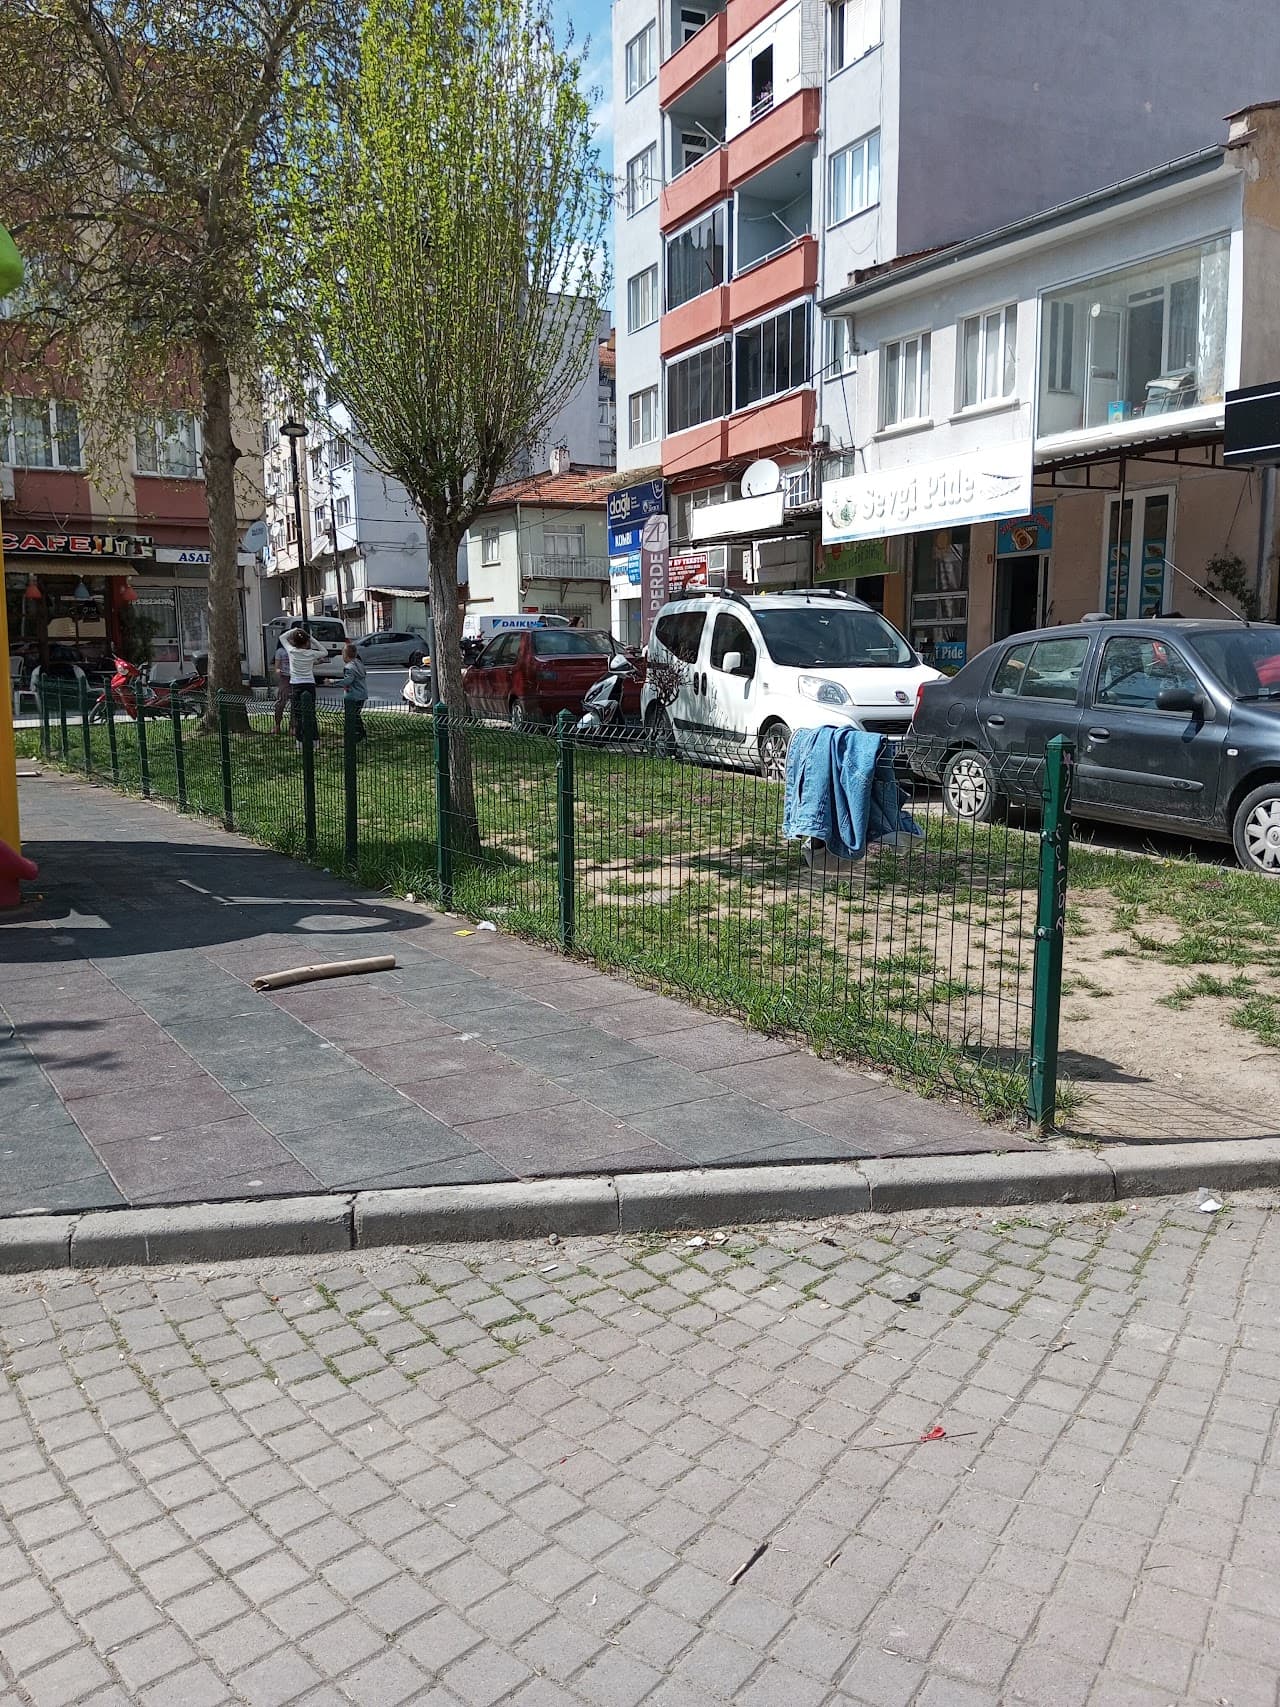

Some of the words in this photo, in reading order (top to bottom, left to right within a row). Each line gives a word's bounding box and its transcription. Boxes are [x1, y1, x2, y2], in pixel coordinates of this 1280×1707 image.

[863, 478, 917, 521] Sevgi
[924, 469, 975, 510] Pide
[2, 533, 91, 552] CAFE
[650, 553, 665, 611] PERDE
[942, 646, 963, 659] Pide
